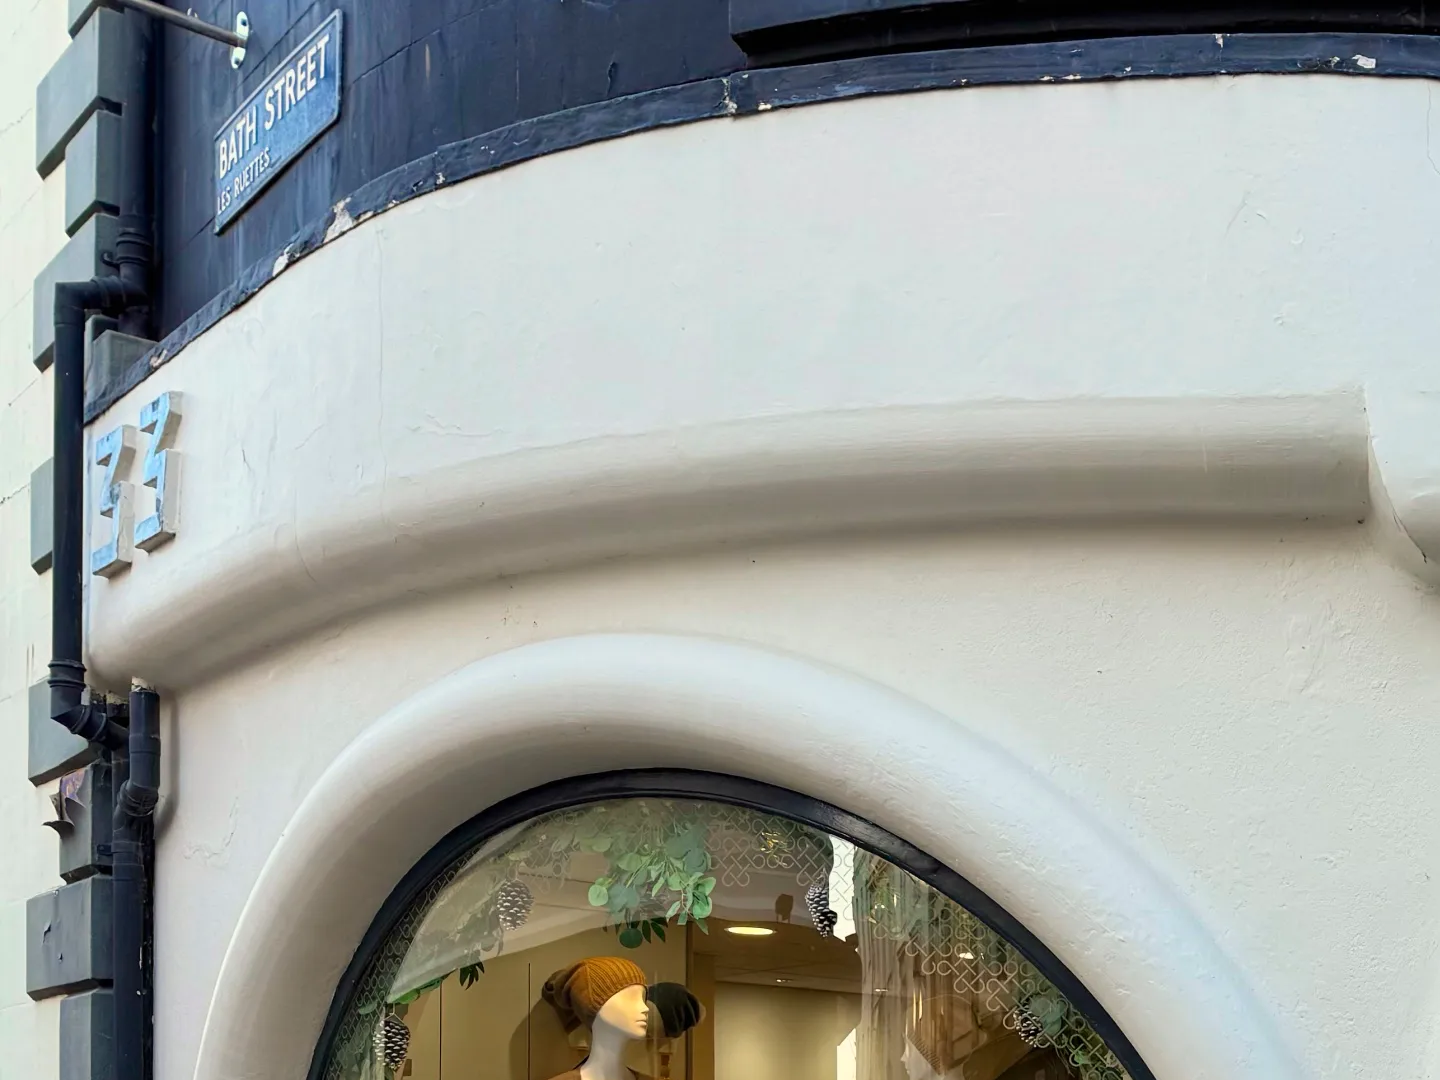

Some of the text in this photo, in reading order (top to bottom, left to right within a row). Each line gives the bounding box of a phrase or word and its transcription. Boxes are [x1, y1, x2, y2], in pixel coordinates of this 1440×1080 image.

[219, 33, 330, 179] BATH STREET
[217, 146, 271, 214] LES RUETTES
